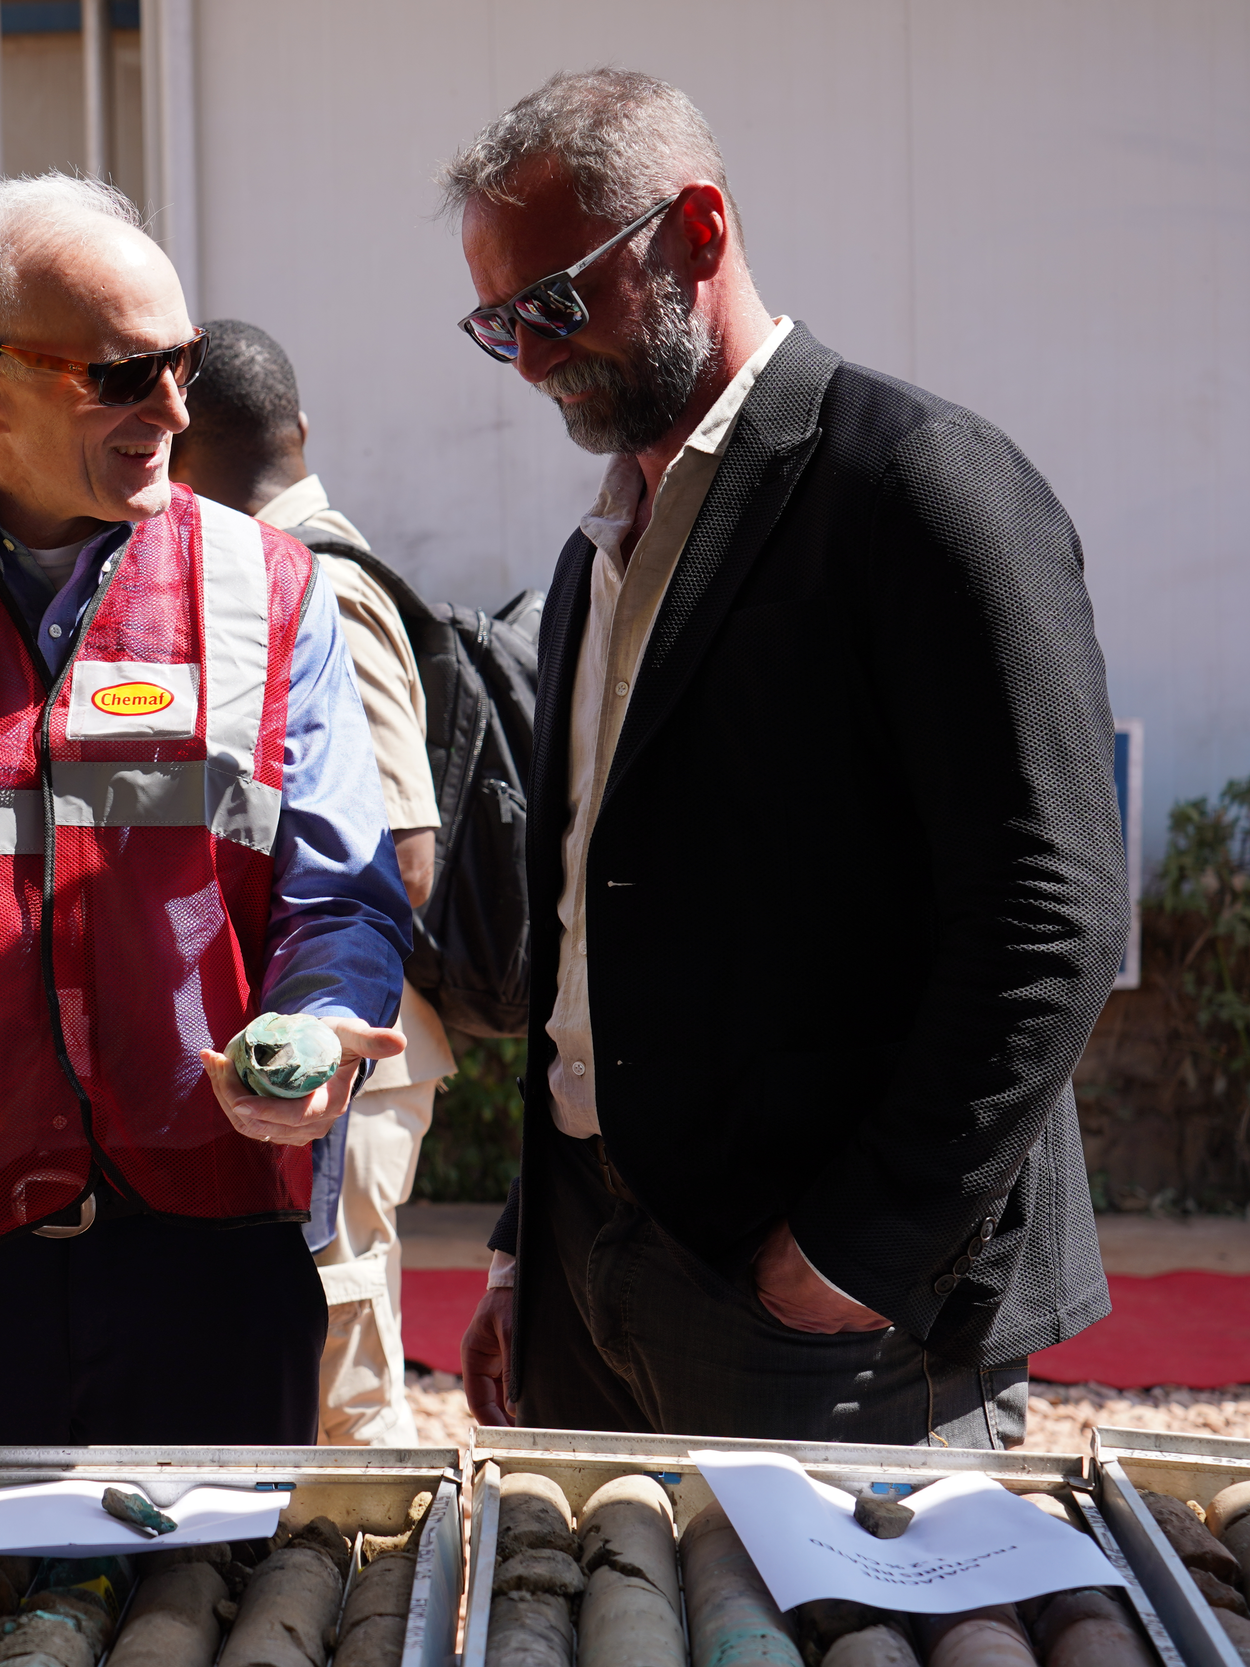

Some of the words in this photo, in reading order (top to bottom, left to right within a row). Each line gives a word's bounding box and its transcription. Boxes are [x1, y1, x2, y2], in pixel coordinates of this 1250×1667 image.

[101, 691, 166, 706] Chemaf
[809, 1538, 895, 1577] RELATED
[900, 1545, 1018, 1578] FRACTURES
[860, 1563, 981, 1585] MALACHITE
